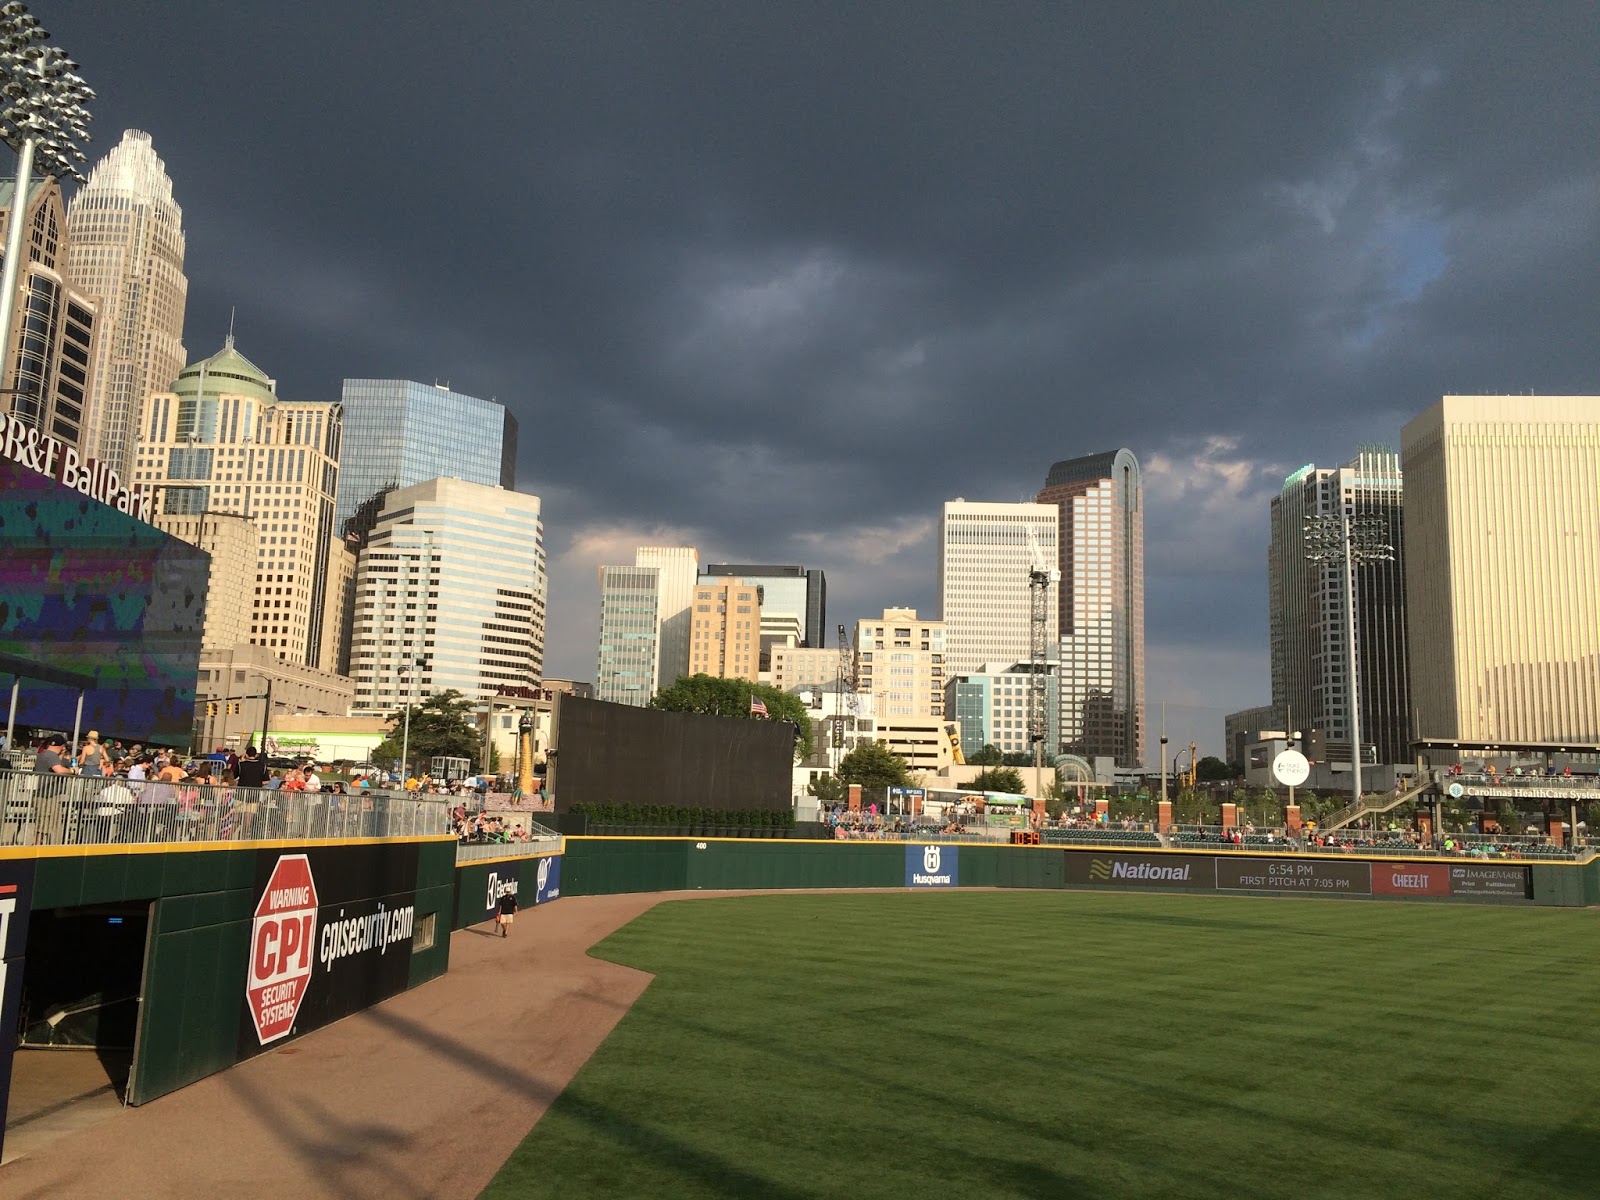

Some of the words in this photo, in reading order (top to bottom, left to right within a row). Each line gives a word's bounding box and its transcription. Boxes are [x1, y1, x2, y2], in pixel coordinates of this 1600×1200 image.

[62, 446, 151, 524] BallPark
[1467, 787, 1512, 797] Carolinas
[1514, 788, 1568, 799] HealthCare
[696, 842, 707, 850] 400
[913, 873, 951, 885] Husqvarna
[1111, 861, 1190, 880] National
[1268, 864, 1294, 875] 6:54
[1297, 865, 1314, 876] PM
[1239, 876, 1266, 885] FIRST
[1268, 877, 1296, 887] PITCH
[1298, 878, 1311, 887] AT
[1314, 879, 1334, 888] 7:05
[1336, 879, 1350, 888] PM
[1392, 873, 1429, 888] CHEEZ-IT
[269, 886, 310, 910] WARNING
[320, 902, 415, 972] cpisecurity.com
[255, 915, 313, 981] CPI
[261, 980, 298, 1008] SECURITY
[260, 1000, 296, 1028] SYSTEMS
